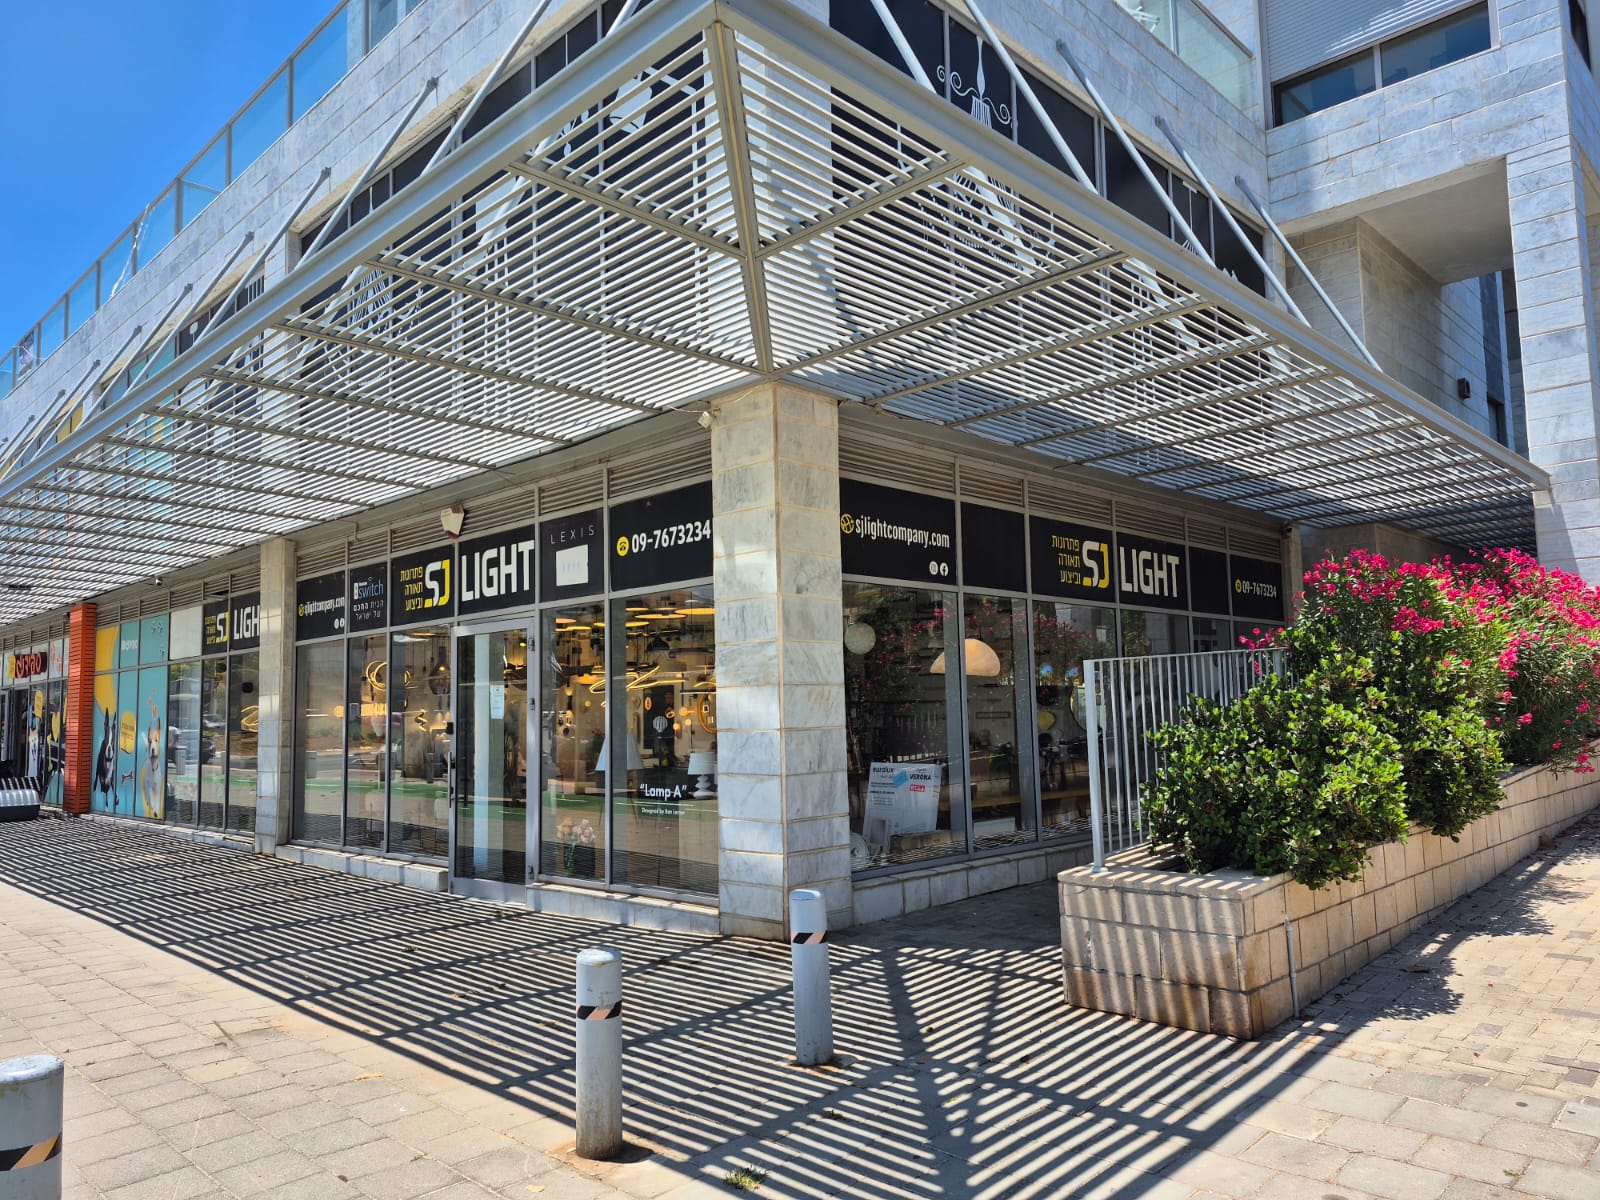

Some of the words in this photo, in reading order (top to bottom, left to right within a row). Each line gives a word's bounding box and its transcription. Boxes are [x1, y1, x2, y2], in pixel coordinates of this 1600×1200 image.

[550, 524, 594, 544] LEXIS
[631, 519, 711, 553] 09-7673234
[855, 515, 950, 548] sjlightcompany.com
[1051, 535, 1080, 552] פתרונות
[1058, 552, 1081, 568] תאורה
[400, 566, 424, 581] פתרונות
[461, 539, 534, 603] LIGHT
[1060, 570, 1081, 585] וביצוע
[1120, 546, 1180, 598] LIGHT
[404, 582, 423, 596] תאורה
[1242, 579, 1277, 598] 09-7673234
[353, 602, 368, 612] החכם
[370, 600, 384, 609] הבית
[405, 597, 423, 611] וביצוע
[234, 604, 260, 640] LIGH
[909, 773, 932, 781] VERONA
